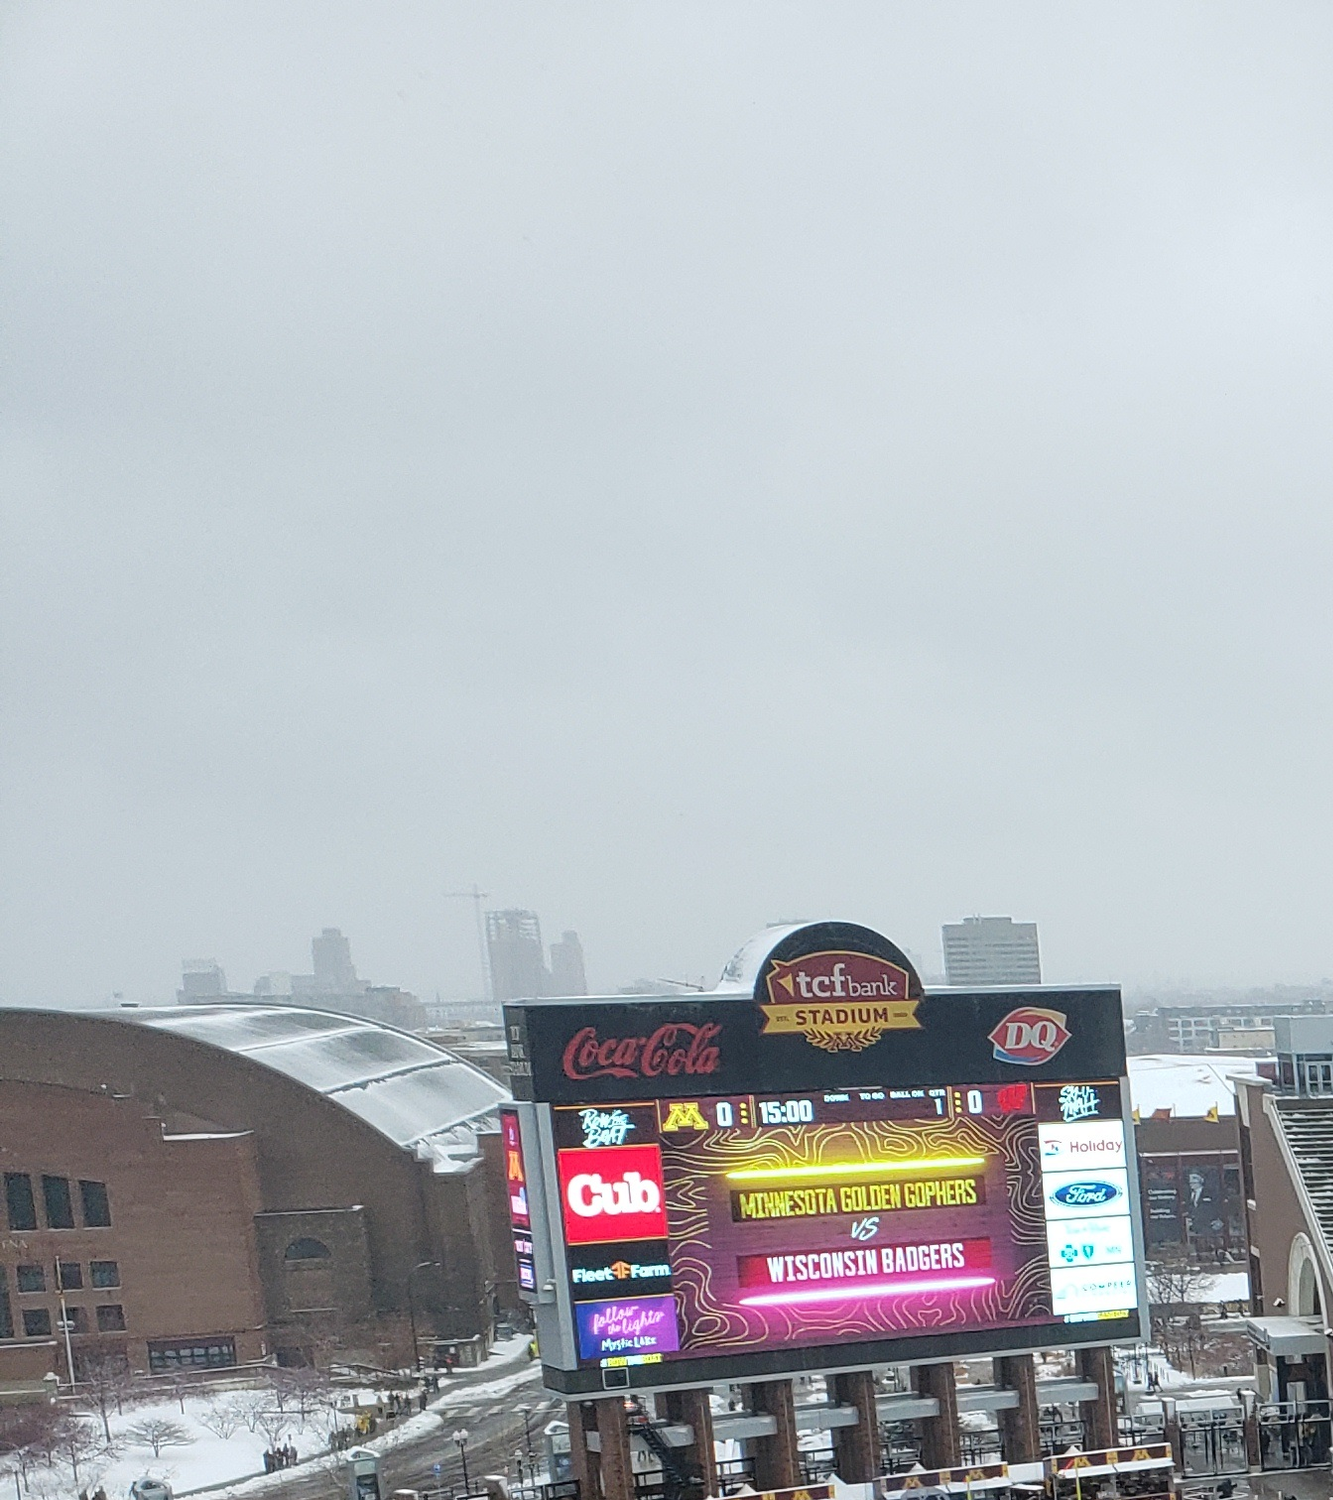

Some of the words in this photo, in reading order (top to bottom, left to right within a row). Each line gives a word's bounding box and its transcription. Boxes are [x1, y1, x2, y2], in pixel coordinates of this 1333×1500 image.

[796, 963, 846, 998] tcf
[849, 974, 898, 998] bank
[795, 1007, 889, 1027] STADIUM
[1004, 1021, 1060, 1051] DQ
[562, 1022, 722, 1080] Coca-Cola
[758, 1099, 814, 1124] 15:00
[933, 1099, 943, 1116] 1
[967, 1089, 984, 1114] 0
[716, 1102, 733, 1127] 0
[1070, 1140, 1122, 1154] Holiday
[568, 1171, 661, 1218] Cub
[739, 1188, 838, 1219] MINNESOTA
[840, 1183, 902, 1213] GOLDEN
[904, 1179, 977, 1208] GOPHERS
[1066, 1183, 1108, 1204] Ford
[572, 1268, 614, 1283] Fleet
[631, 1264, 672, 1278] Farm
[767, 1249, 878, 1283] WISCONSIN
[881, 1243, 965, 1274] BADGERS
